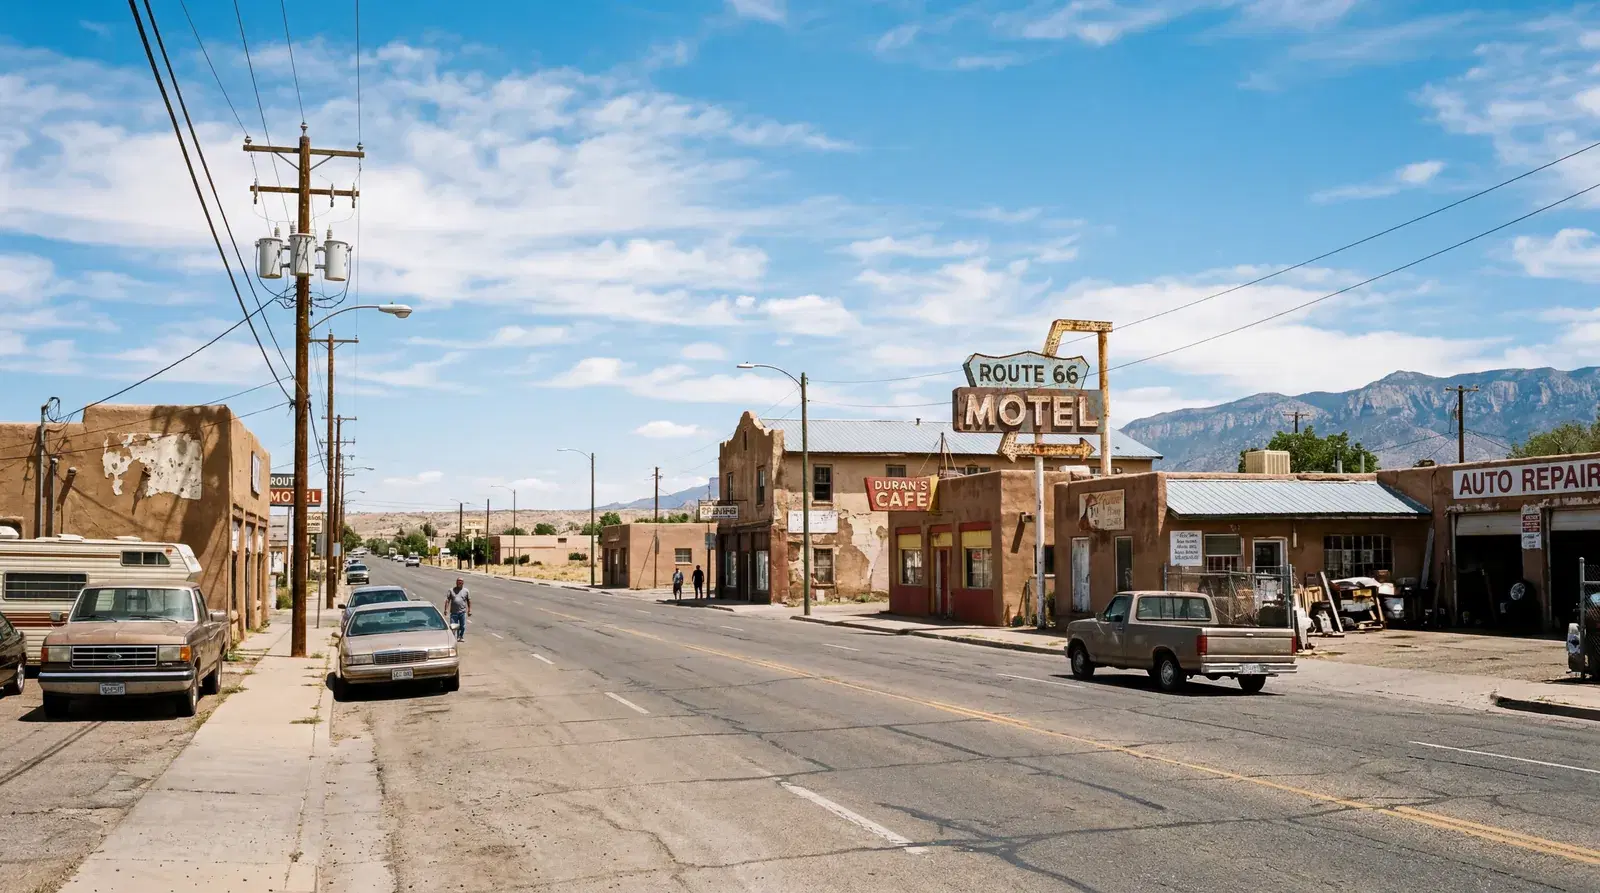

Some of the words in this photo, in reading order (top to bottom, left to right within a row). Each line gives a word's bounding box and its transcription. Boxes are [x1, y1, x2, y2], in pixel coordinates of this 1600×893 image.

[979, 363, 1045, 383] ROUTE
[1053, 364, 1079, 385] 66
[965, 393, 1099, 427] MOTEL
[874, 480, 928, 491] DURAN'S
[1459, 469, 1513, 495] AUTO
[1522, 462, 1600, 491] REPAIR
[270, 491, 320, 503] MOL
[875, 491, 928, 507] CAFE
